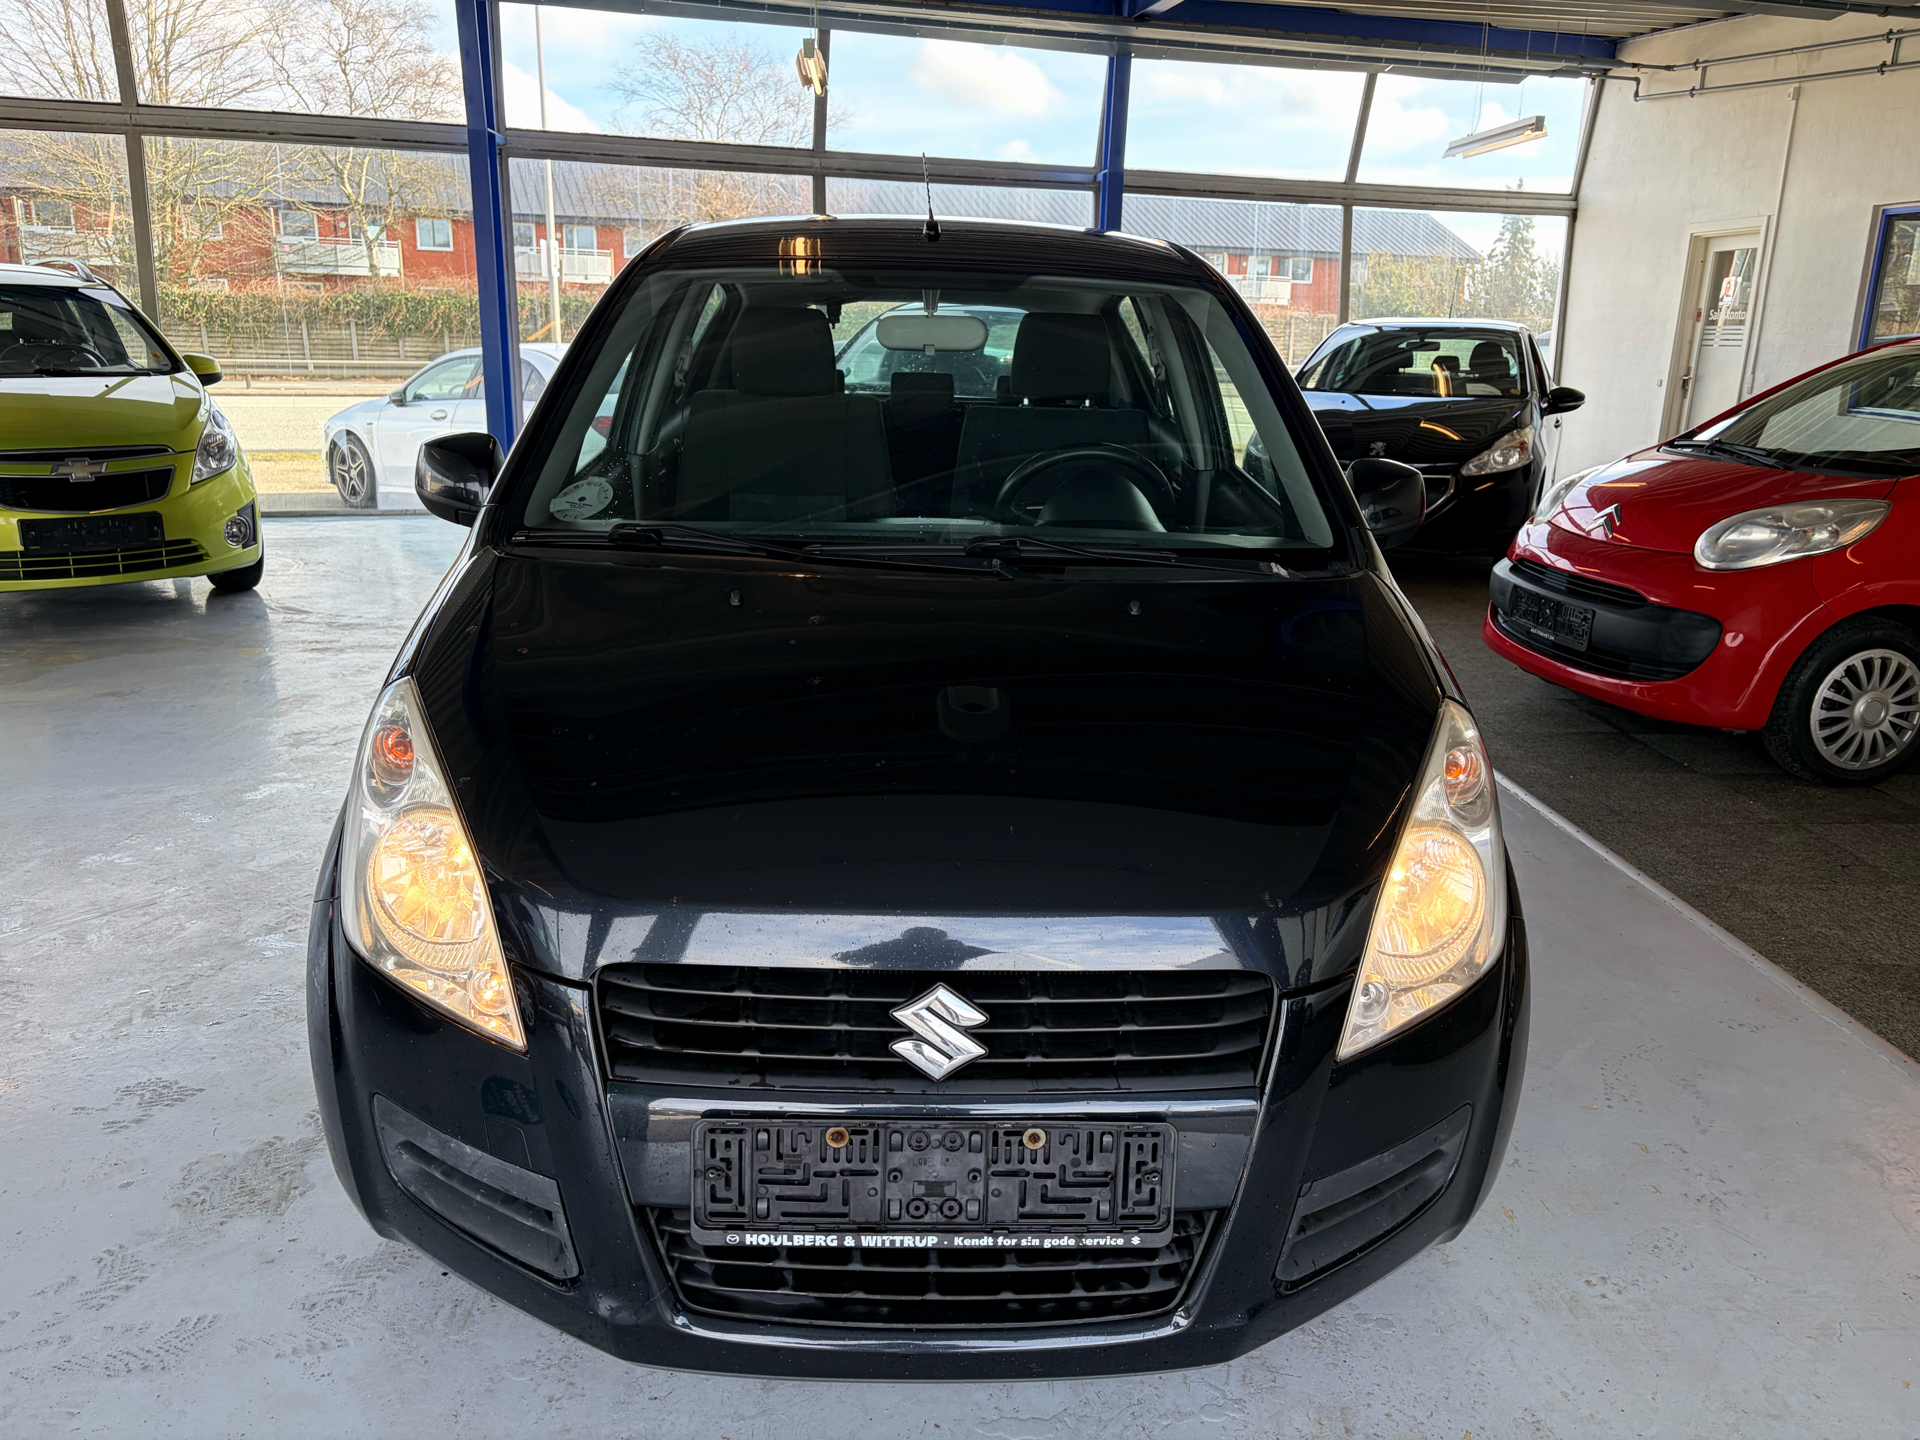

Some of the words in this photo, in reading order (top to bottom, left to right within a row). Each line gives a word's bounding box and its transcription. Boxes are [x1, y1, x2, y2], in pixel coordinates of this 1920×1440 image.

[745, 1233, 838, 1247] HOULBERG
[843, 1234, 856, 1247] &
[860, 1235, 939, 1248] WITTRUP
[953, 1236, 994, 1246] Kendt
[997, 1236, 1018, 1246] for
[1020, 1236, 1040, 1246] sin
[1043, 1236, 1076, 1248] gode
